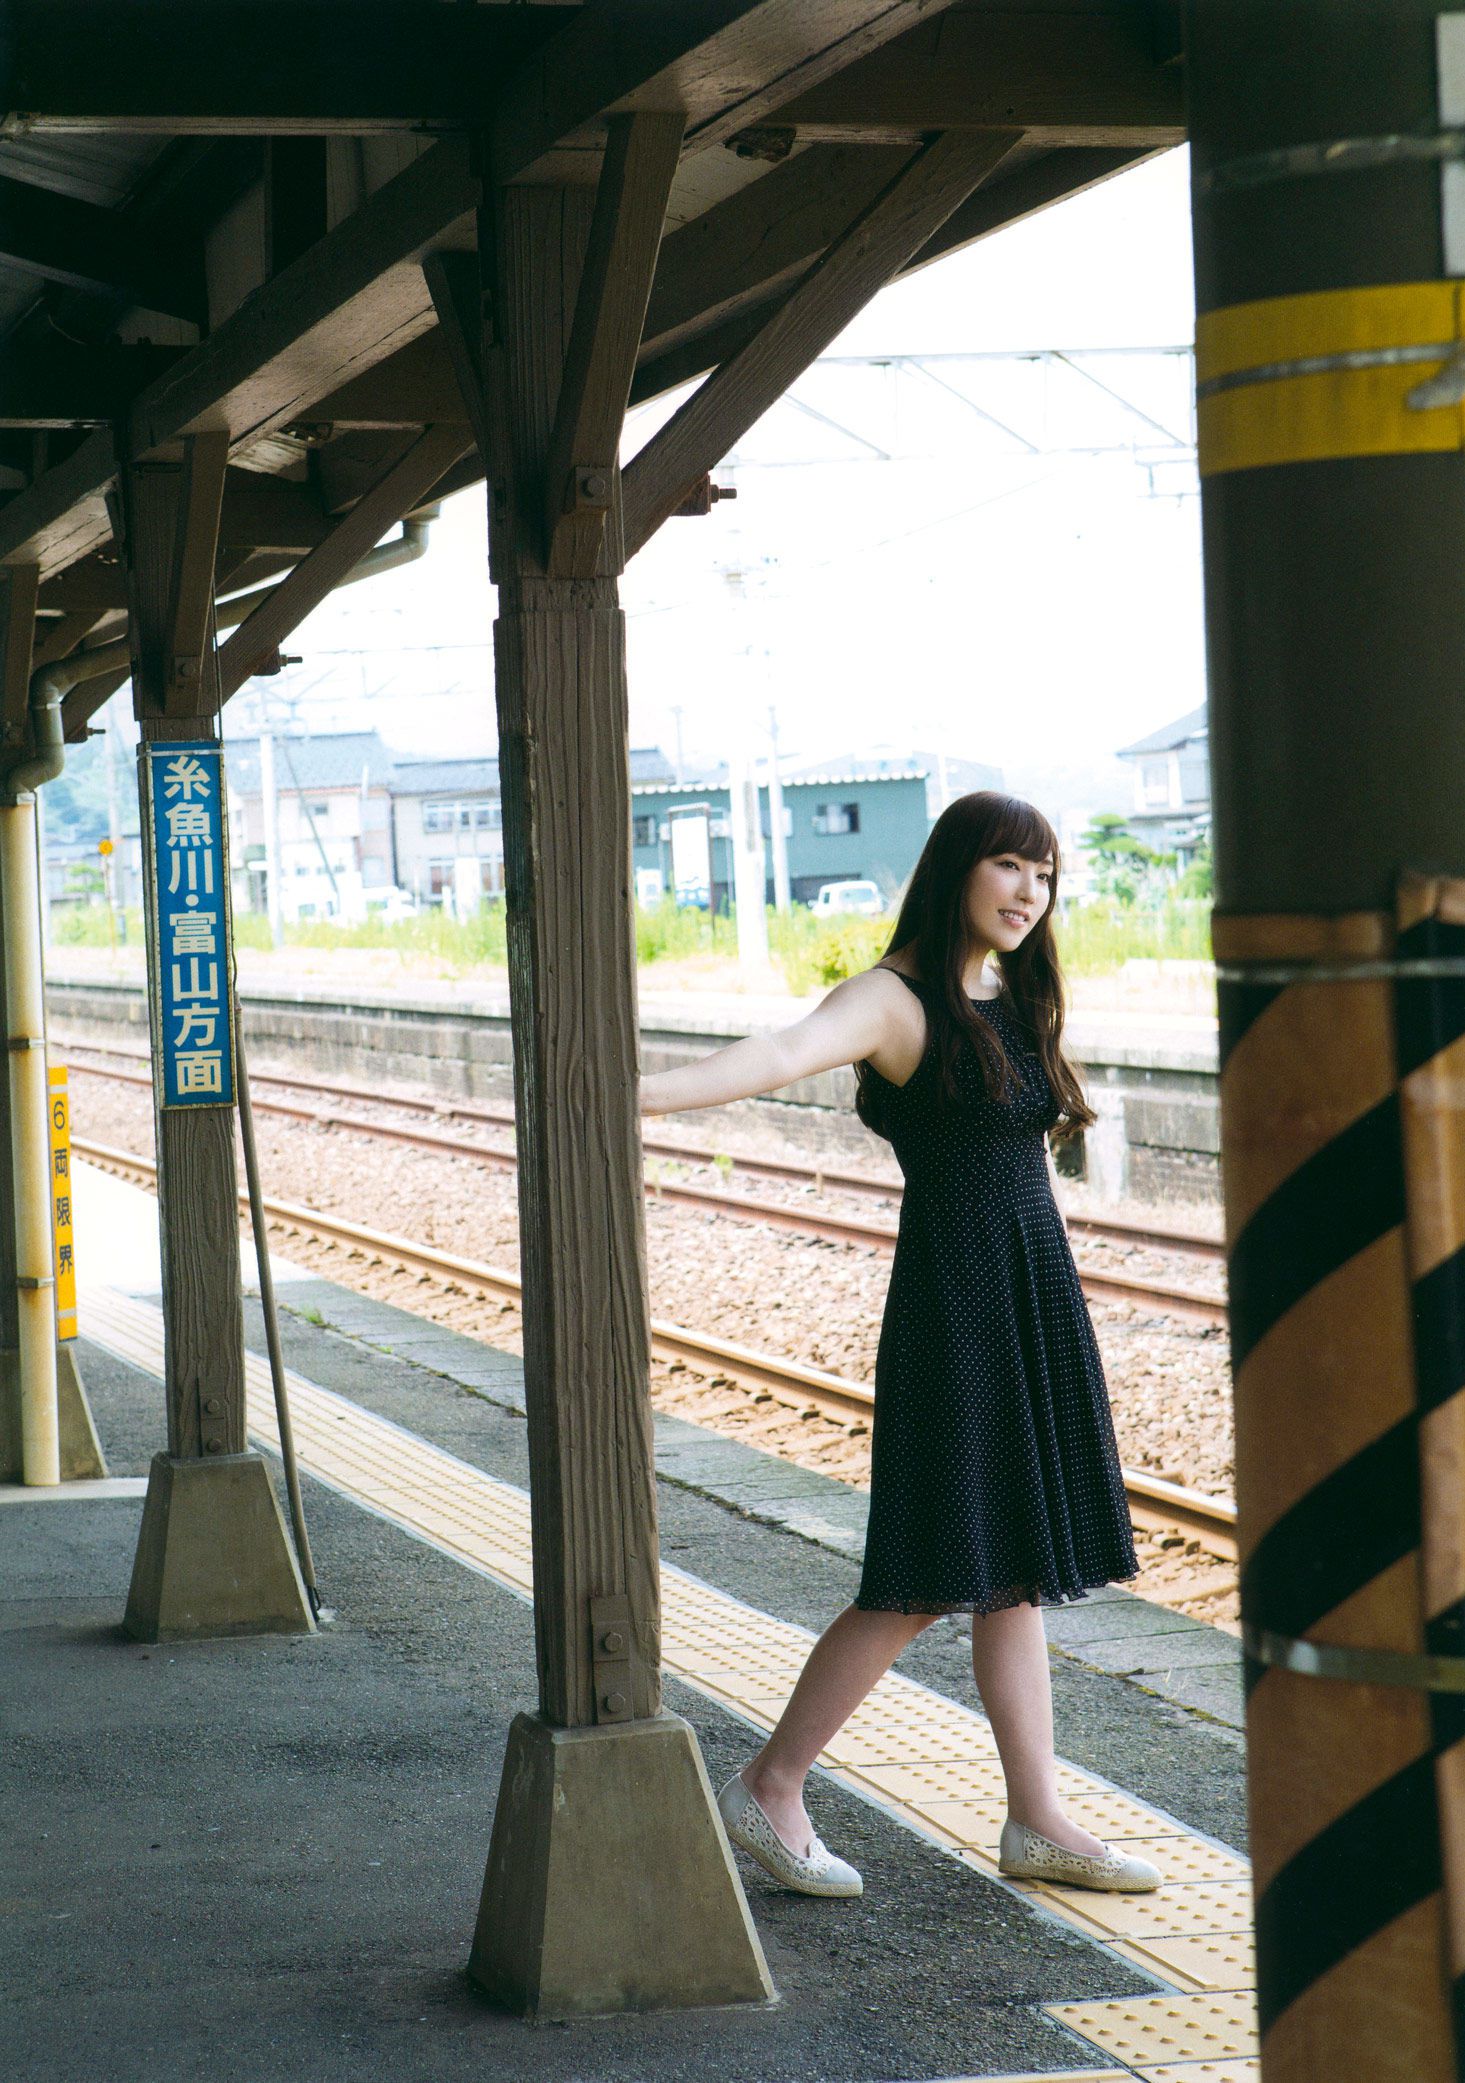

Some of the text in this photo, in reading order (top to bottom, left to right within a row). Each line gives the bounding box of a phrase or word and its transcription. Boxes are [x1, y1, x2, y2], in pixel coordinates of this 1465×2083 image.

[164, 755, 223, 1095] 糸魚川・富山方面
[53, 1100, 72, 1275] 6両限界
